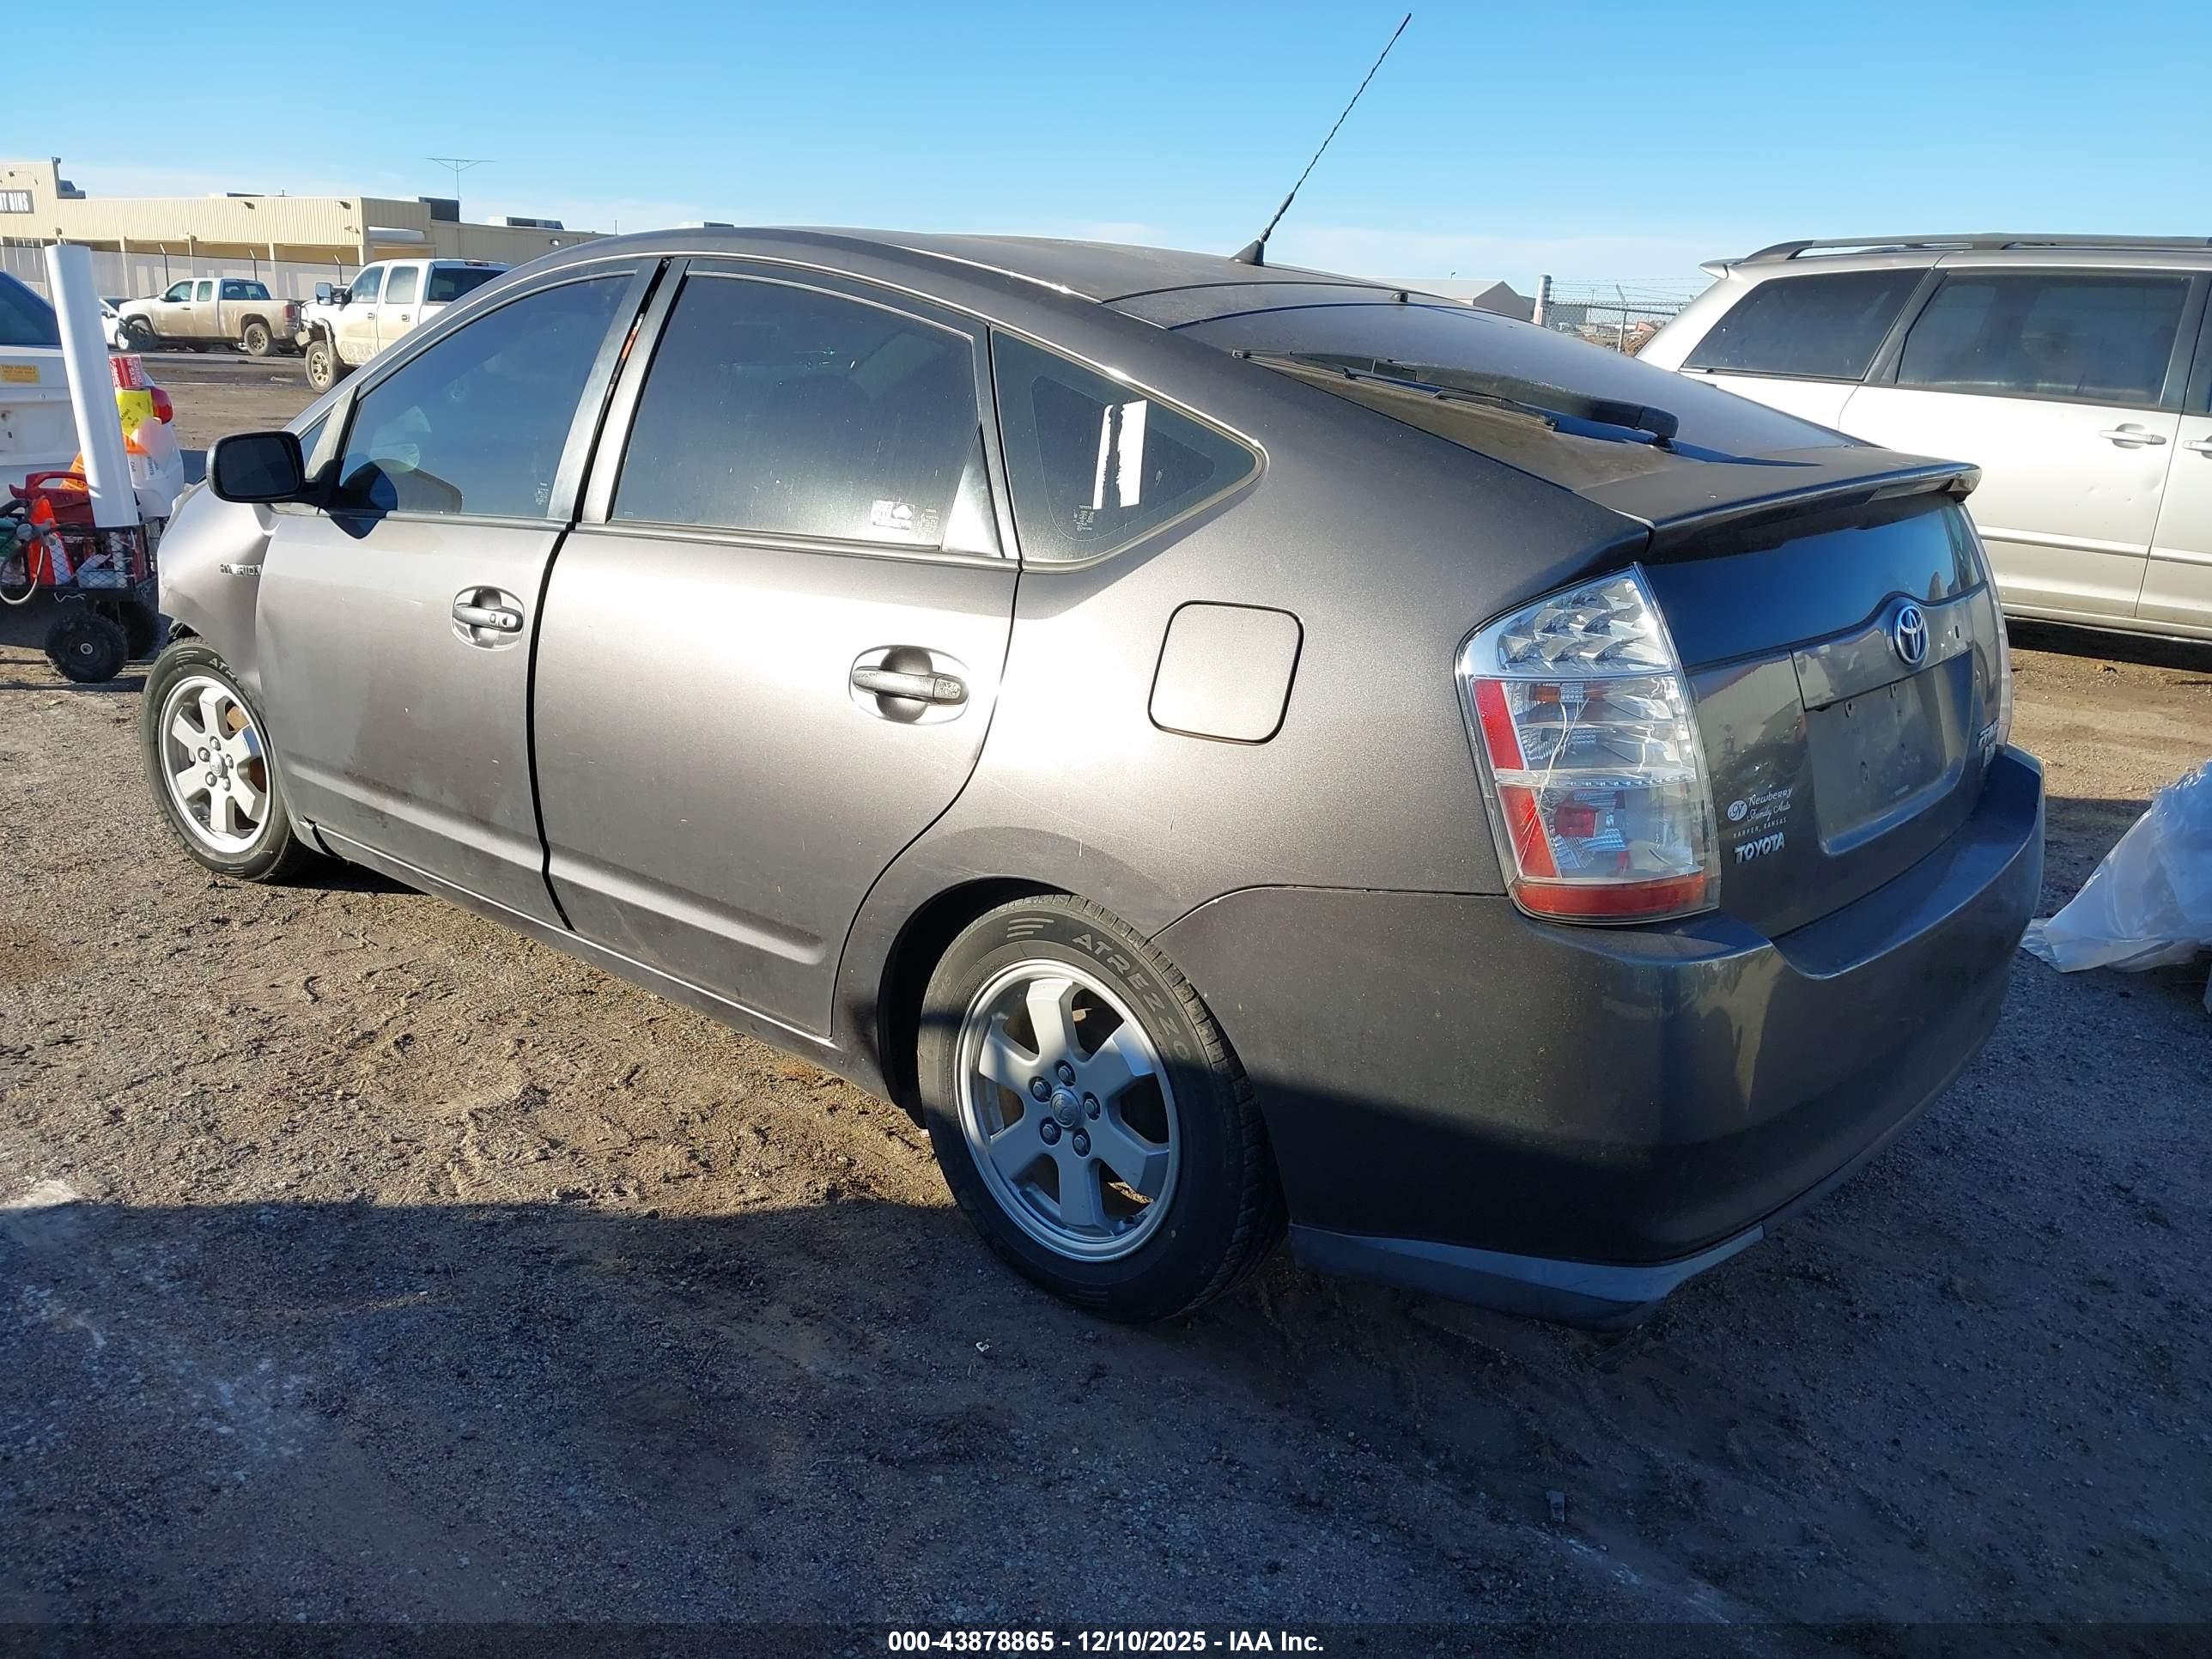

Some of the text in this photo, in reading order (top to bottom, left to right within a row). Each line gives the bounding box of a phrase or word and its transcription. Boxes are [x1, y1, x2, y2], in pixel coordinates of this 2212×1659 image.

[9, 192, 29, 211] BINS
[1748, 787, 1793, 807] Newberry
[1747, 805, 1772, 823] Family
[1763, 817, 1787, 830] KANSAS
[1734, 831, 1786, 865] TOYOTA
[1072, 933, 1192, 1061] ATREZZO
